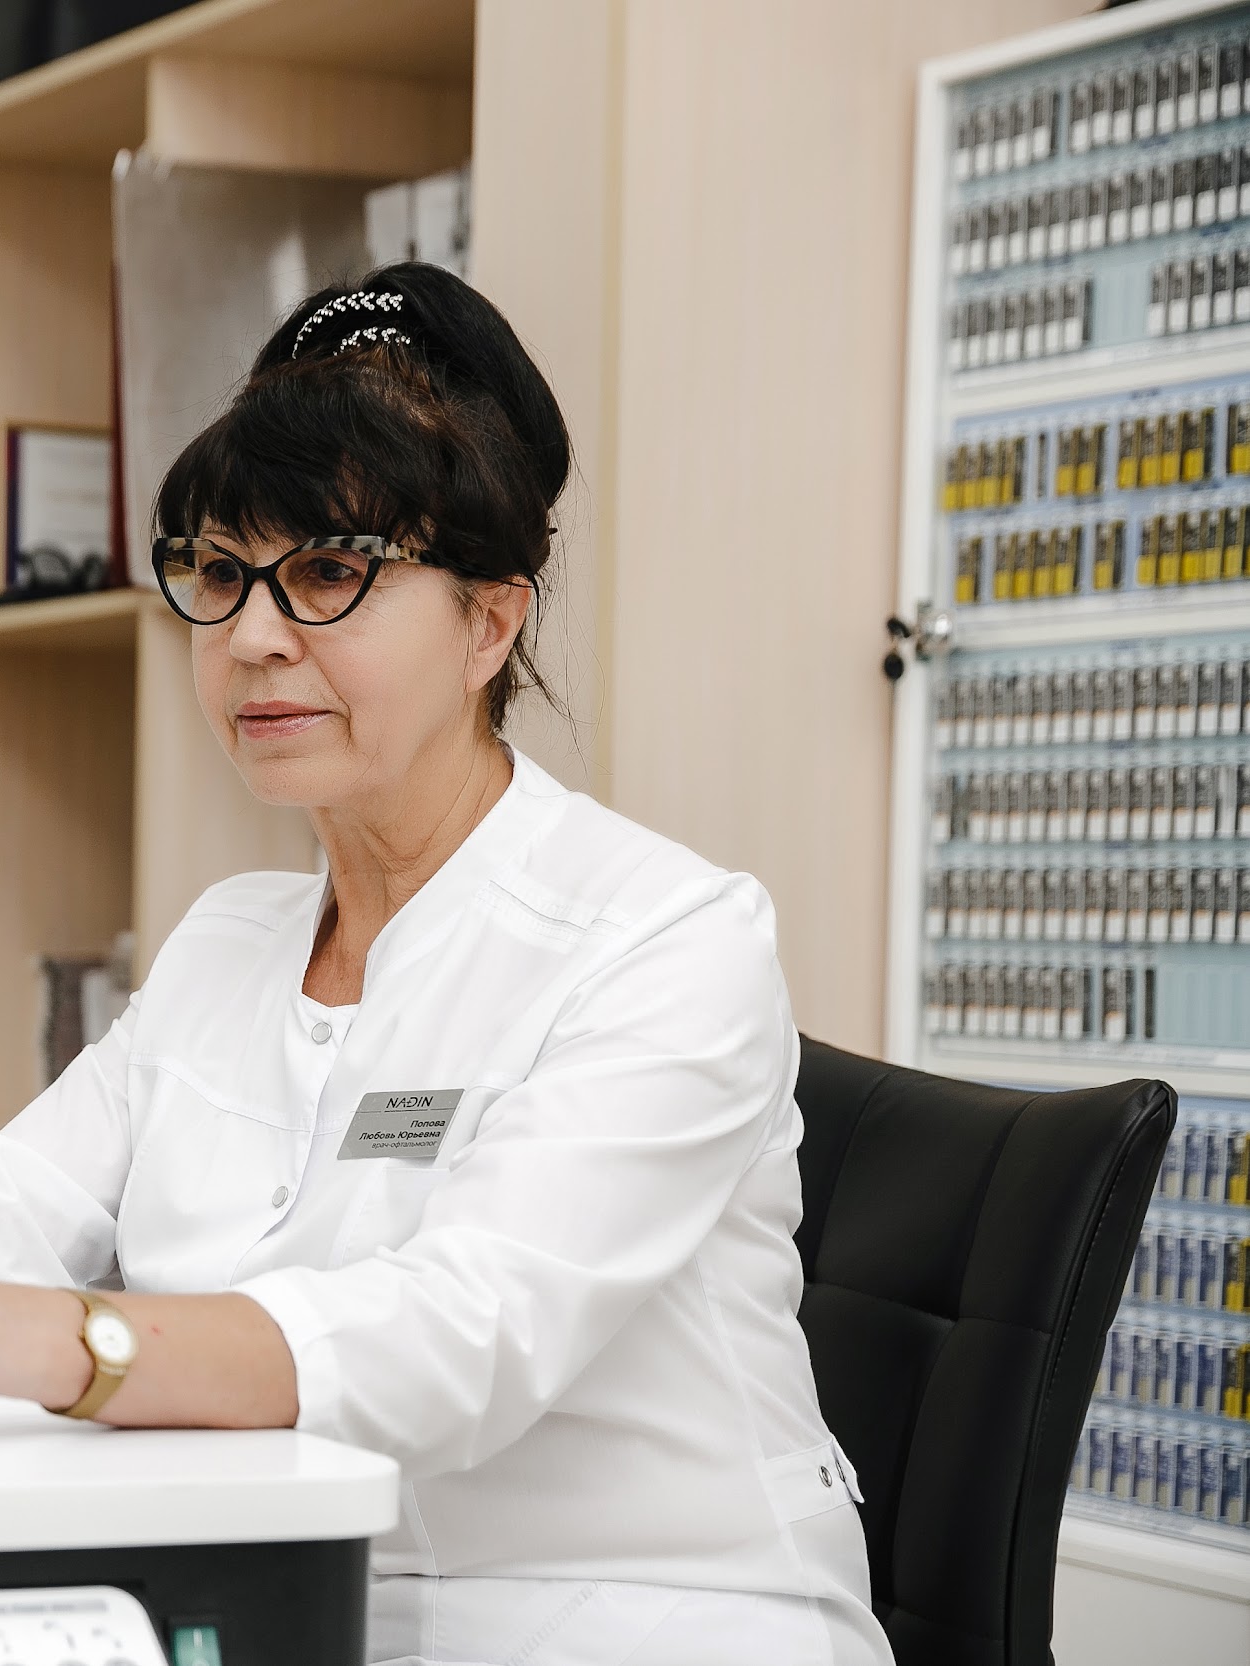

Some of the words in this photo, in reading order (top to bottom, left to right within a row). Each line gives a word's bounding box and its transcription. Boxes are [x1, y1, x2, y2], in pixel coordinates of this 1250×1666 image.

[410, 1119, 446, 1128] Попова
[358, 1131, 396, 1141] Любовь
[397, 1131, 441, 1140] Юрьевна
[371, 1140, 439, 1149] врач-офтальмолог
